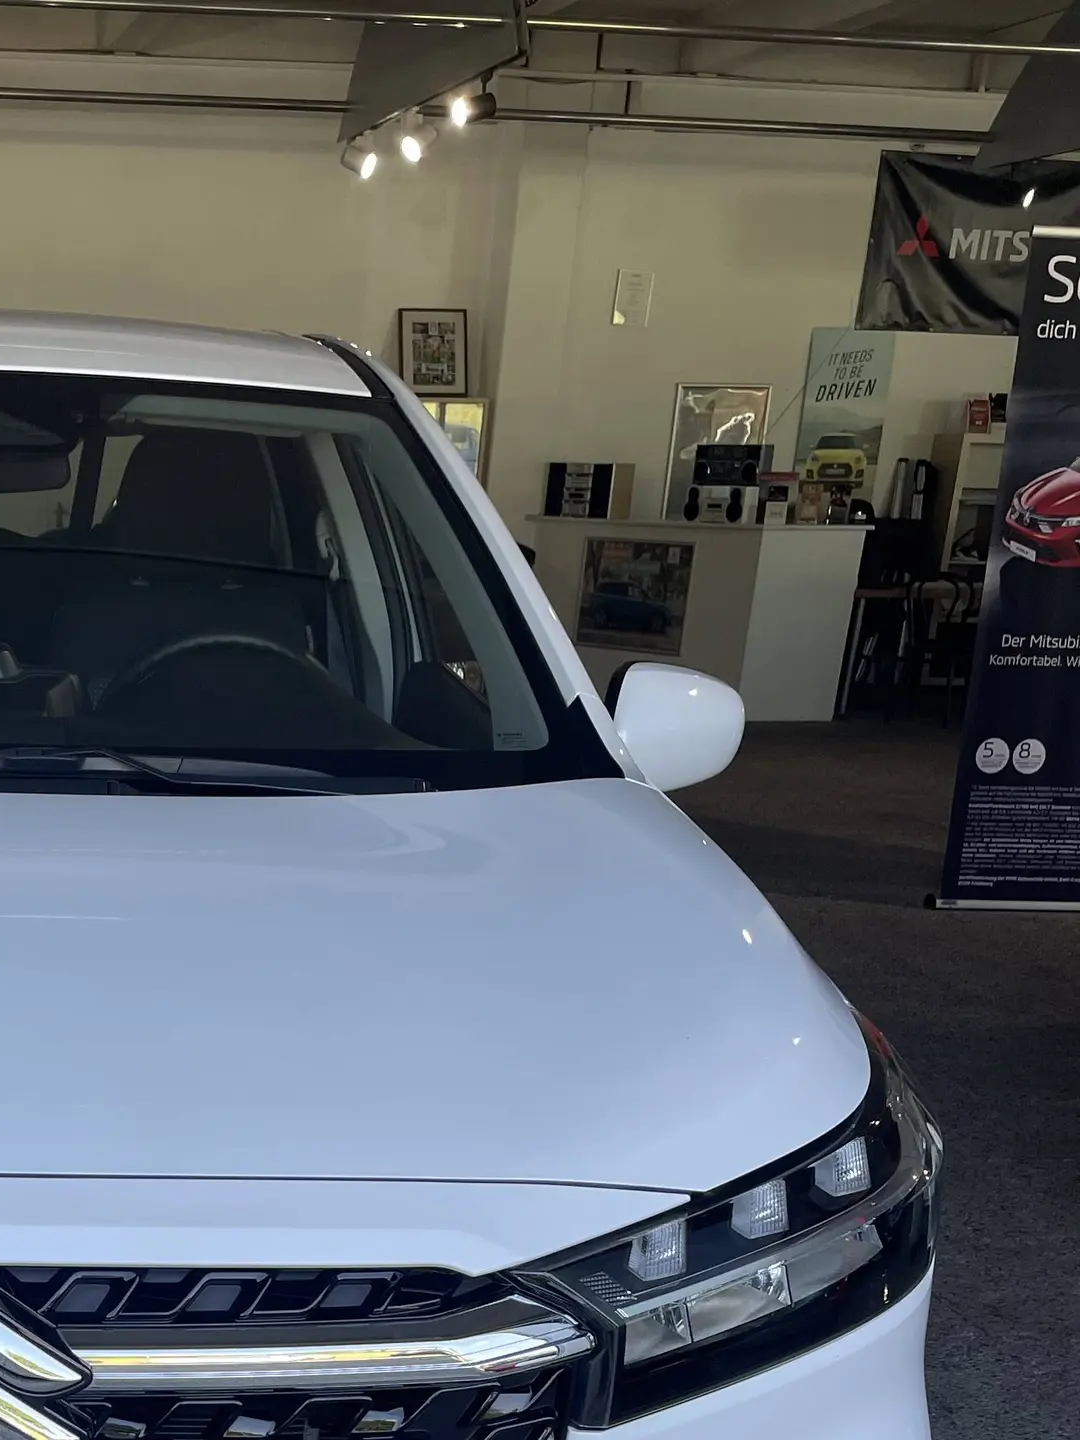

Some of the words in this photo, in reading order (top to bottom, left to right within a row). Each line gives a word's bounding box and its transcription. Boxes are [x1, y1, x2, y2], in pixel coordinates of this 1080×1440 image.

[948, 227, 1030, 263] MITS
[1043, 254, 1080, 304] S
[1036, 319, 1077, 340] dich
[828, 353, 840, 367] IT
[840, 349, 874, 365] NEEDS
[834, 367, 847, 380] TO
[849, 365, 864, 379] BE
[815, 378, 877, 403] DRIVEN
[1001, 634, 1026, 648] Der
[1029, 634, 1080, 649] Mitsubi
[982, 741, 994, 758] 5
[1019, 742, 1031, 759] 8
